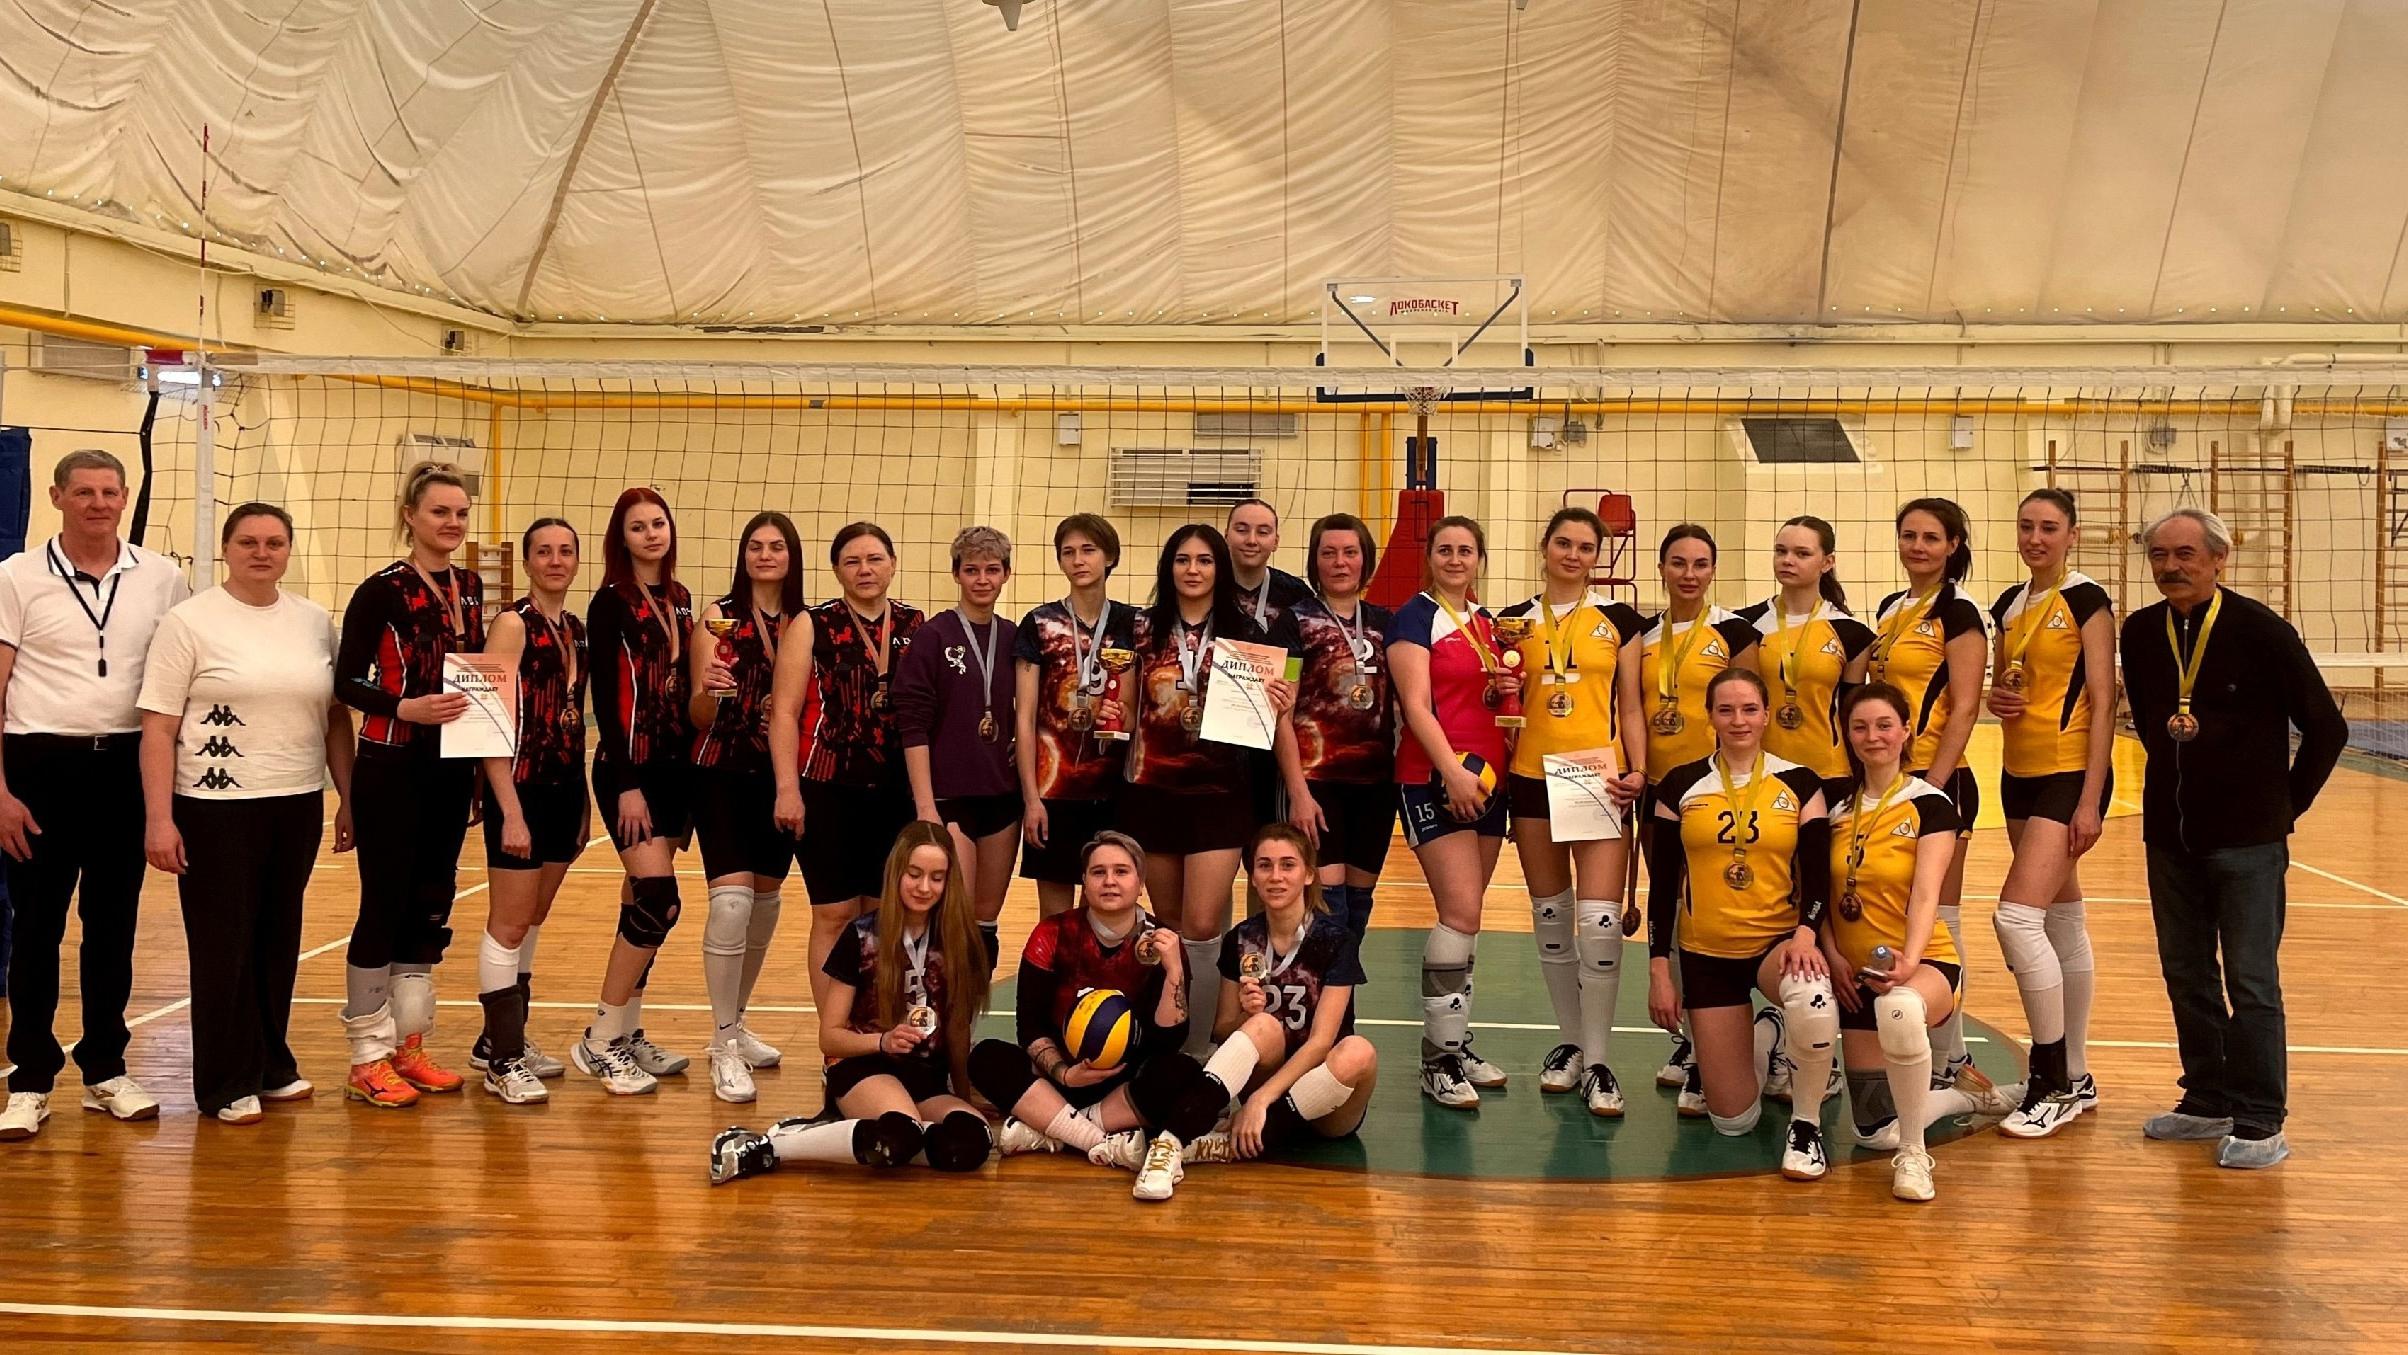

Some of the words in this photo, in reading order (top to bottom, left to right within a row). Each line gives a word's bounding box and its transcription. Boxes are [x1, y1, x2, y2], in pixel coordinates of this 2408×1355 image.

[1390, 299, 1459, 316] ЛОКОБАСКЕТ
[1353, 638, 1378, 675] 2
[1081, 655, 1109, 695] 9
[1221, 660, 1275, 676] ДИПЛОМ
[454, 674, 507, 684] ДИПЛОМ
[1555, 763, 1608, 776] ДИПЛОМ
[1415, 802, 1435, 823] 15
[1717, 810, 1760, 845] 23
